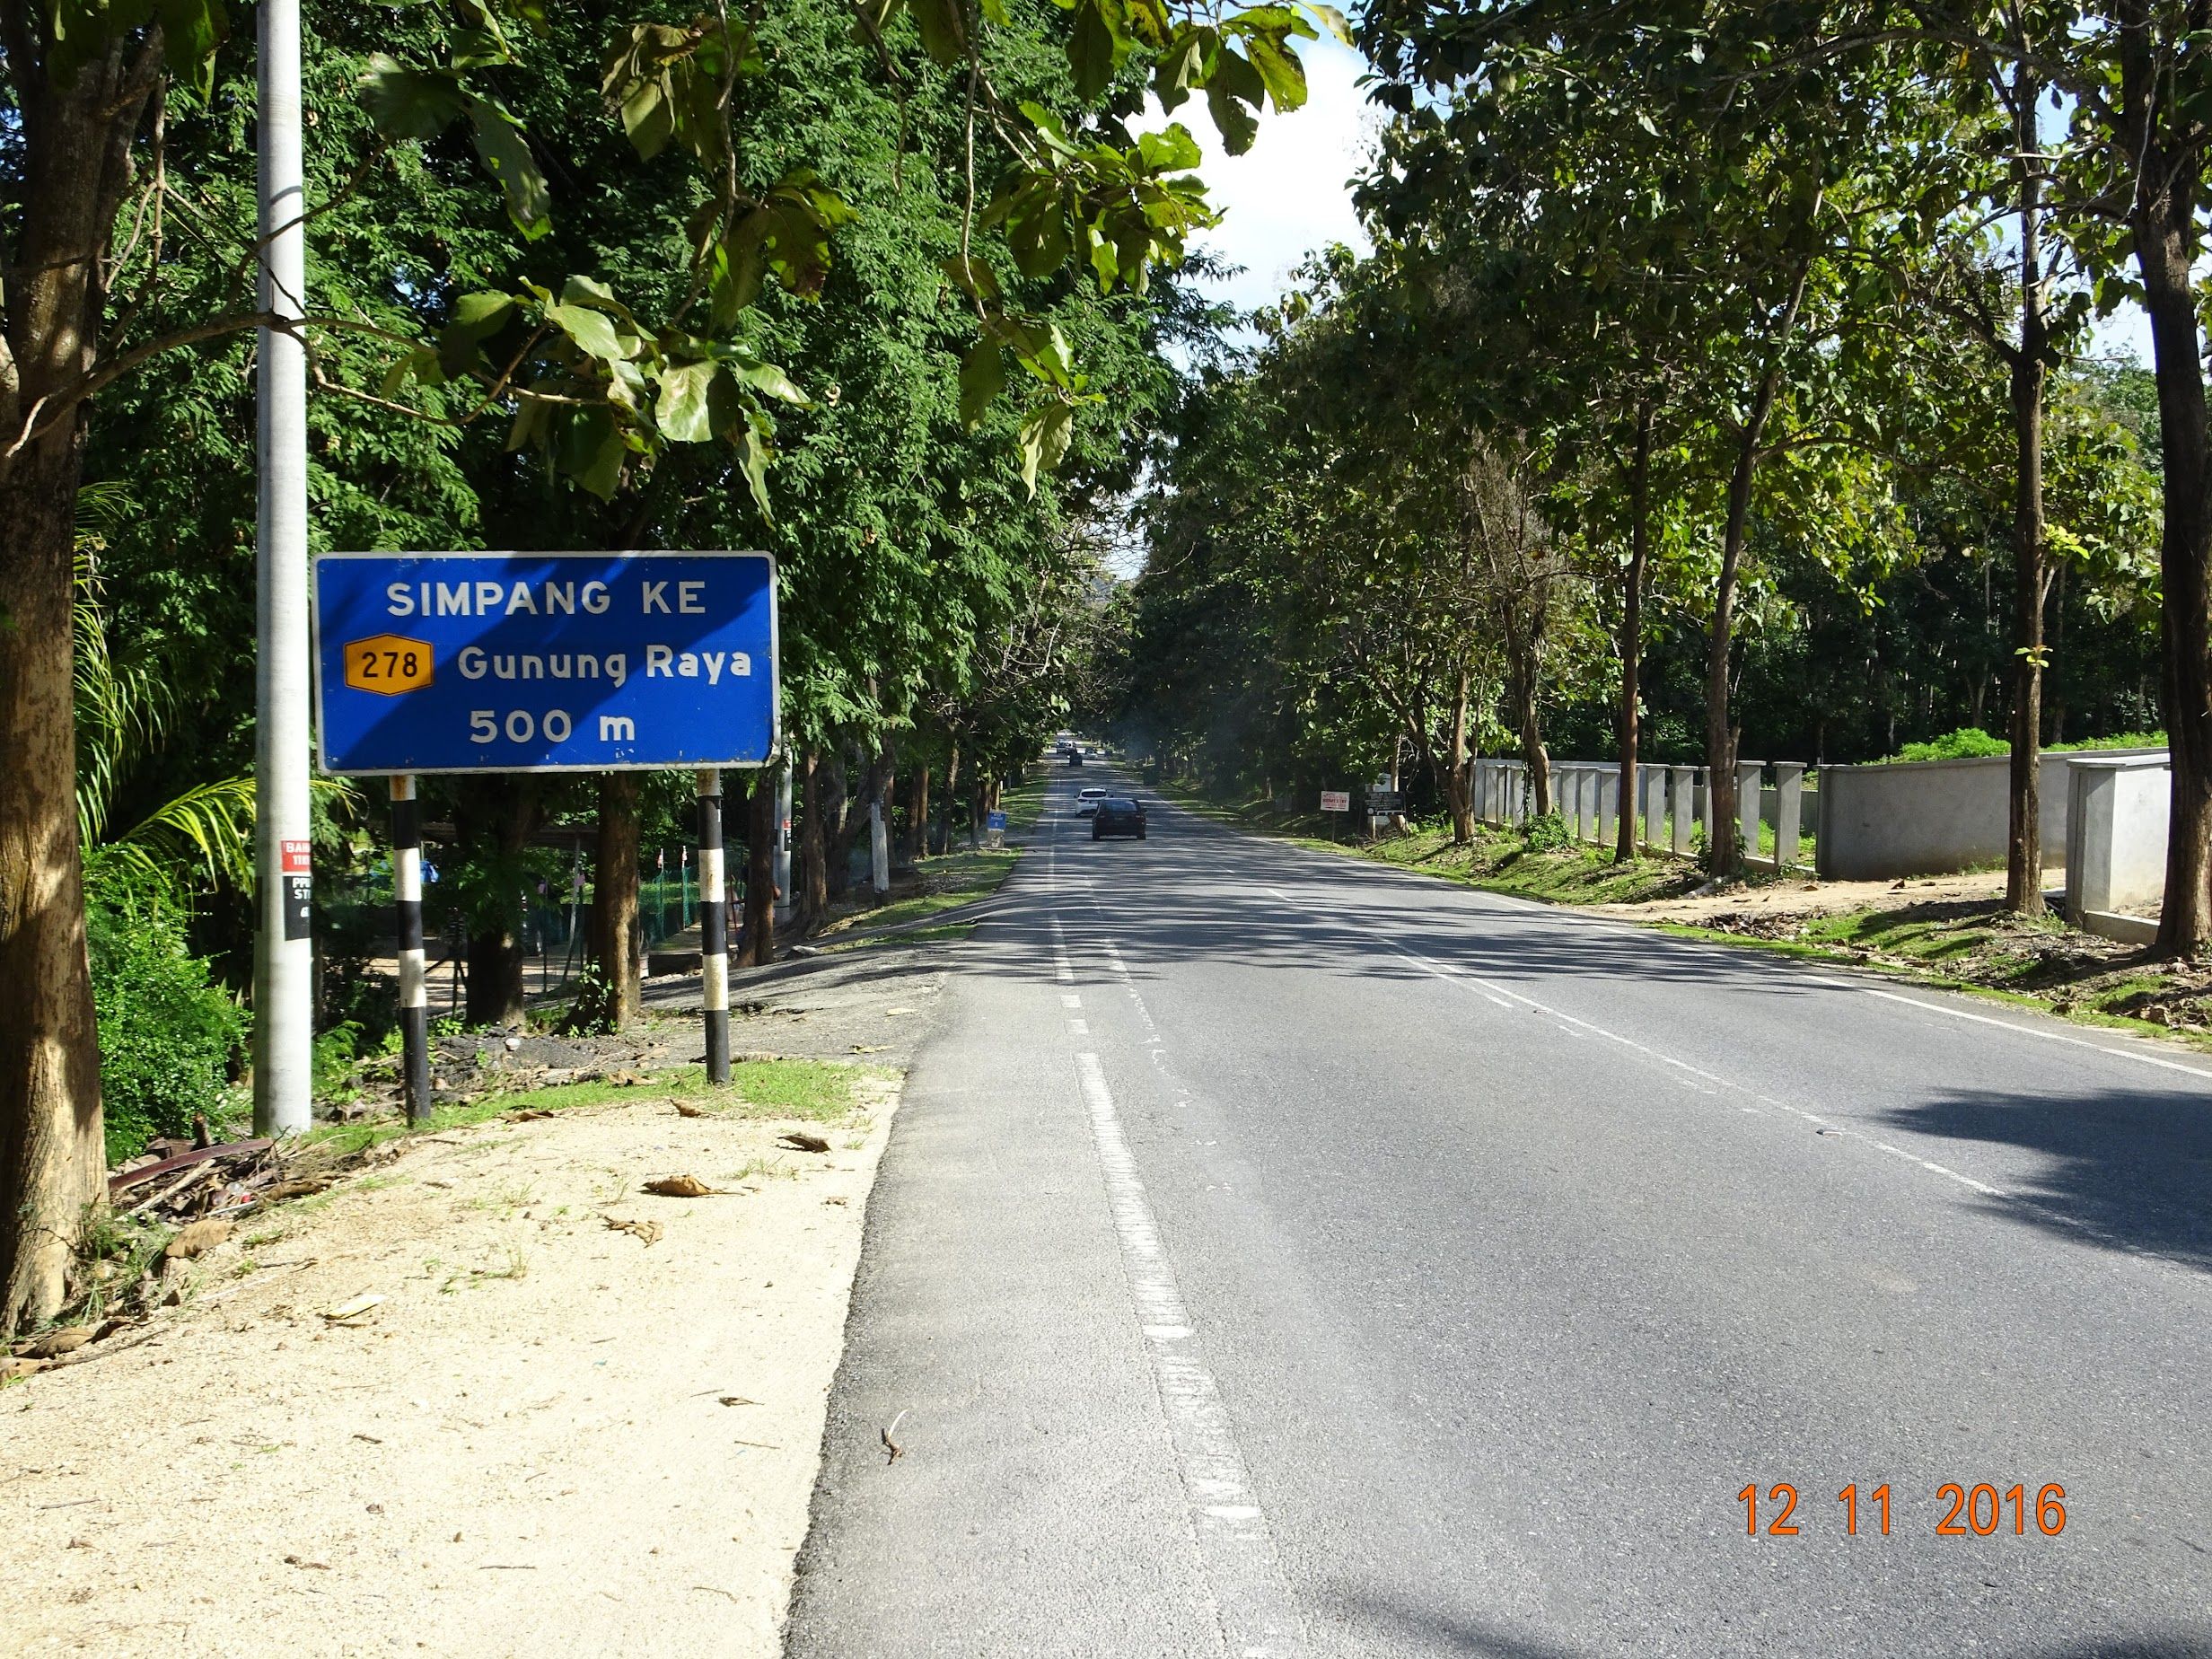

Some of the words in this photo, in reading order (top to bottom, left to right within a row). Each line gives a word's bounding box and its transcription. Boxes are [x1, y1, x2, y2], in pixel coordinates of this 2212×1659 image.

[387, 581, 610, 616] SIMPANG
[643, 581, 706, 614] KE
[362, 652, 417, 678] 278
[459, 646, 626, 687] Gunung
[646, 645, 750, 685] Raya
[470, 709, 571, 743] 500
[600, 715, 636, 742] m
